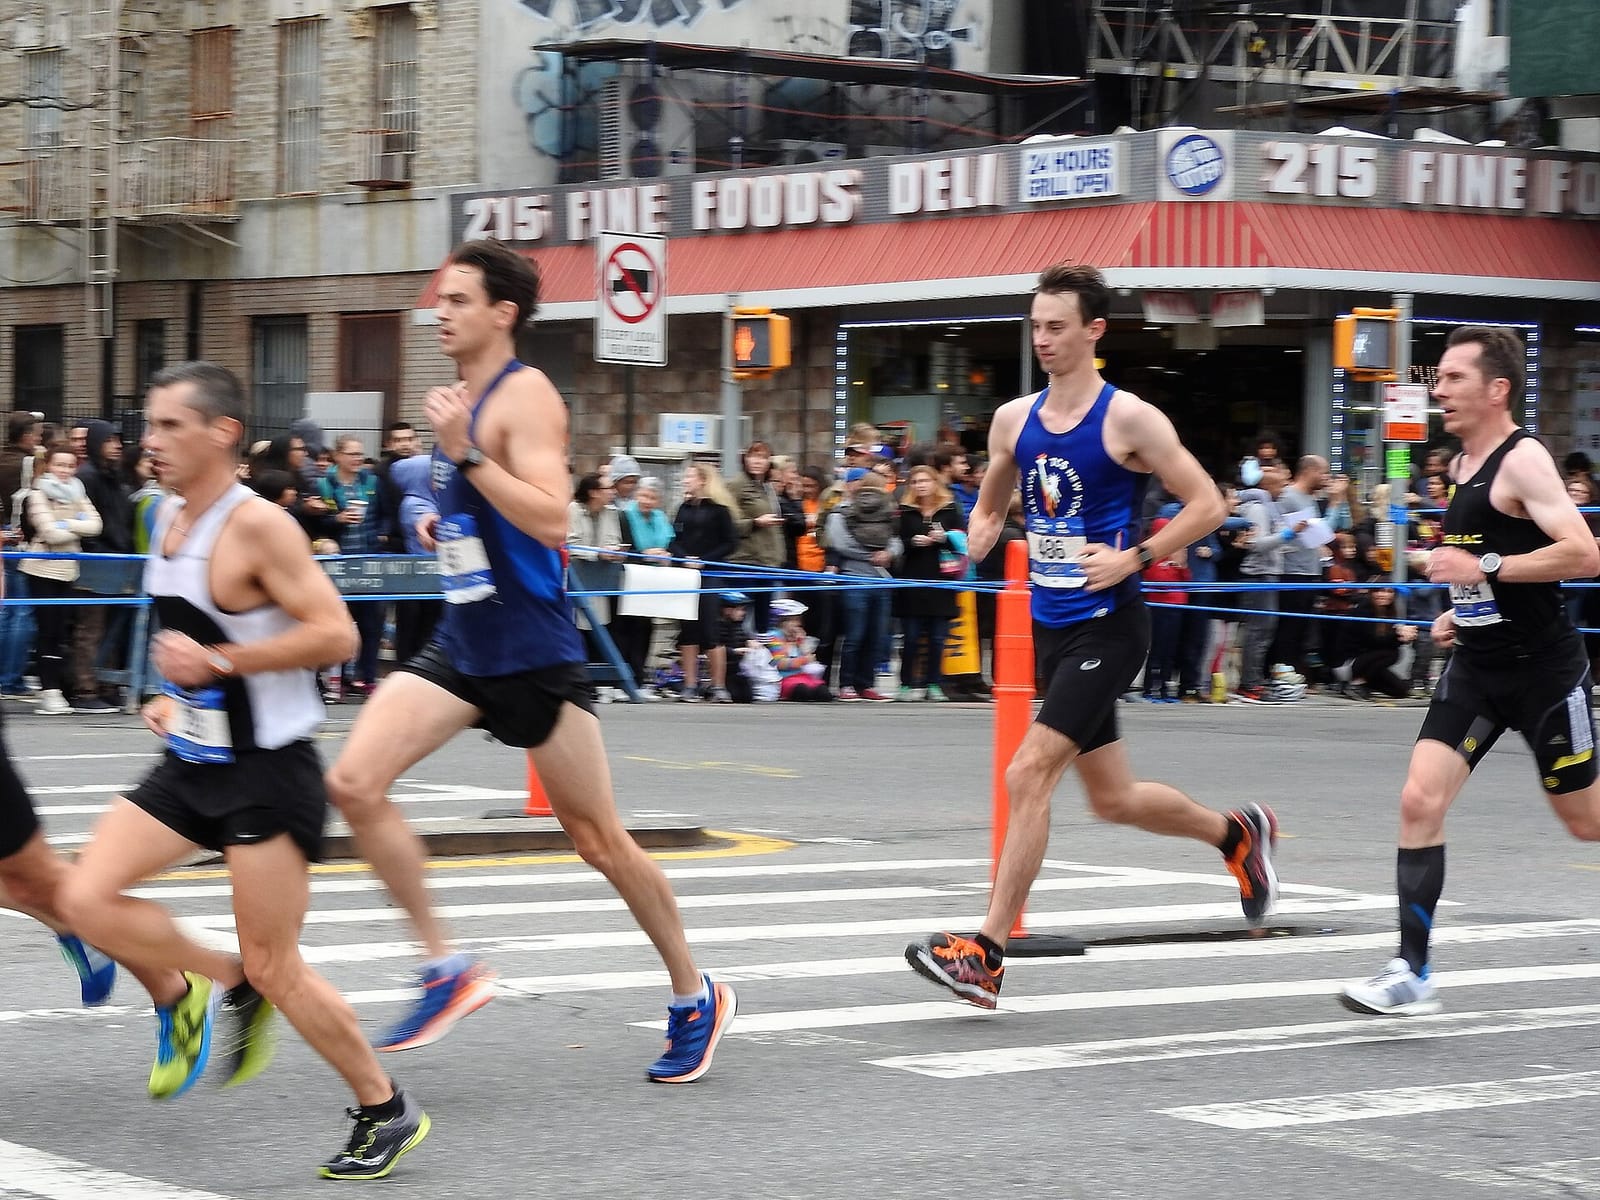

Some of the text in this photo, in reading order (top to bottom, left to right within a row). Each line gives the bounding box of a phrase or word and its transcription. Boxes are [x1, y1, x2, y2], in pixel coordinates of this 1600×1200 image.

[1030, 148, 1111, 175] 24 HOURS
[1030, 173, 1111, 197] GRILL OPEN
[1262, 141, 1377, 198] 215
[1403, 150, 1526, 209] FINE
[463, 152, 1003, 241] 215 FINE FOODS DELI
